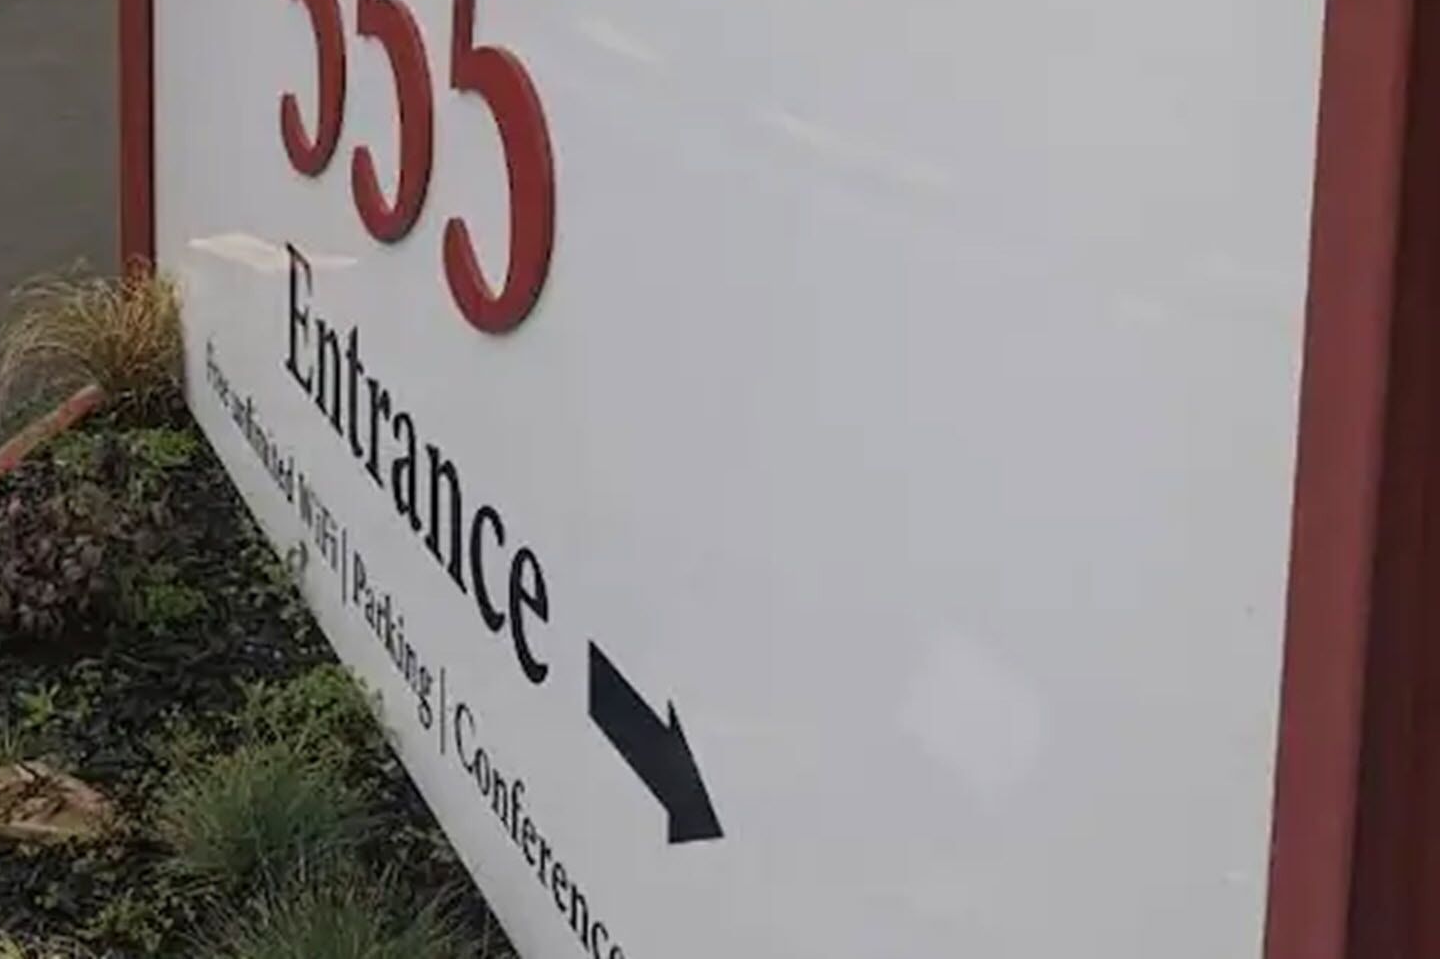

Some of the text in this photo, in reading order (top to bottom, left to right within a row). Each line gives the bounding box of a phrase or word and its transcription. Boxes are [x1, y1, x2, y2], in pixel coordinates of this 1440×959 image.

[285, 242, 550, 685] Entrance
[354, 550, 433, 730] Parking
[454, 703, 625, 959] Conferenc
